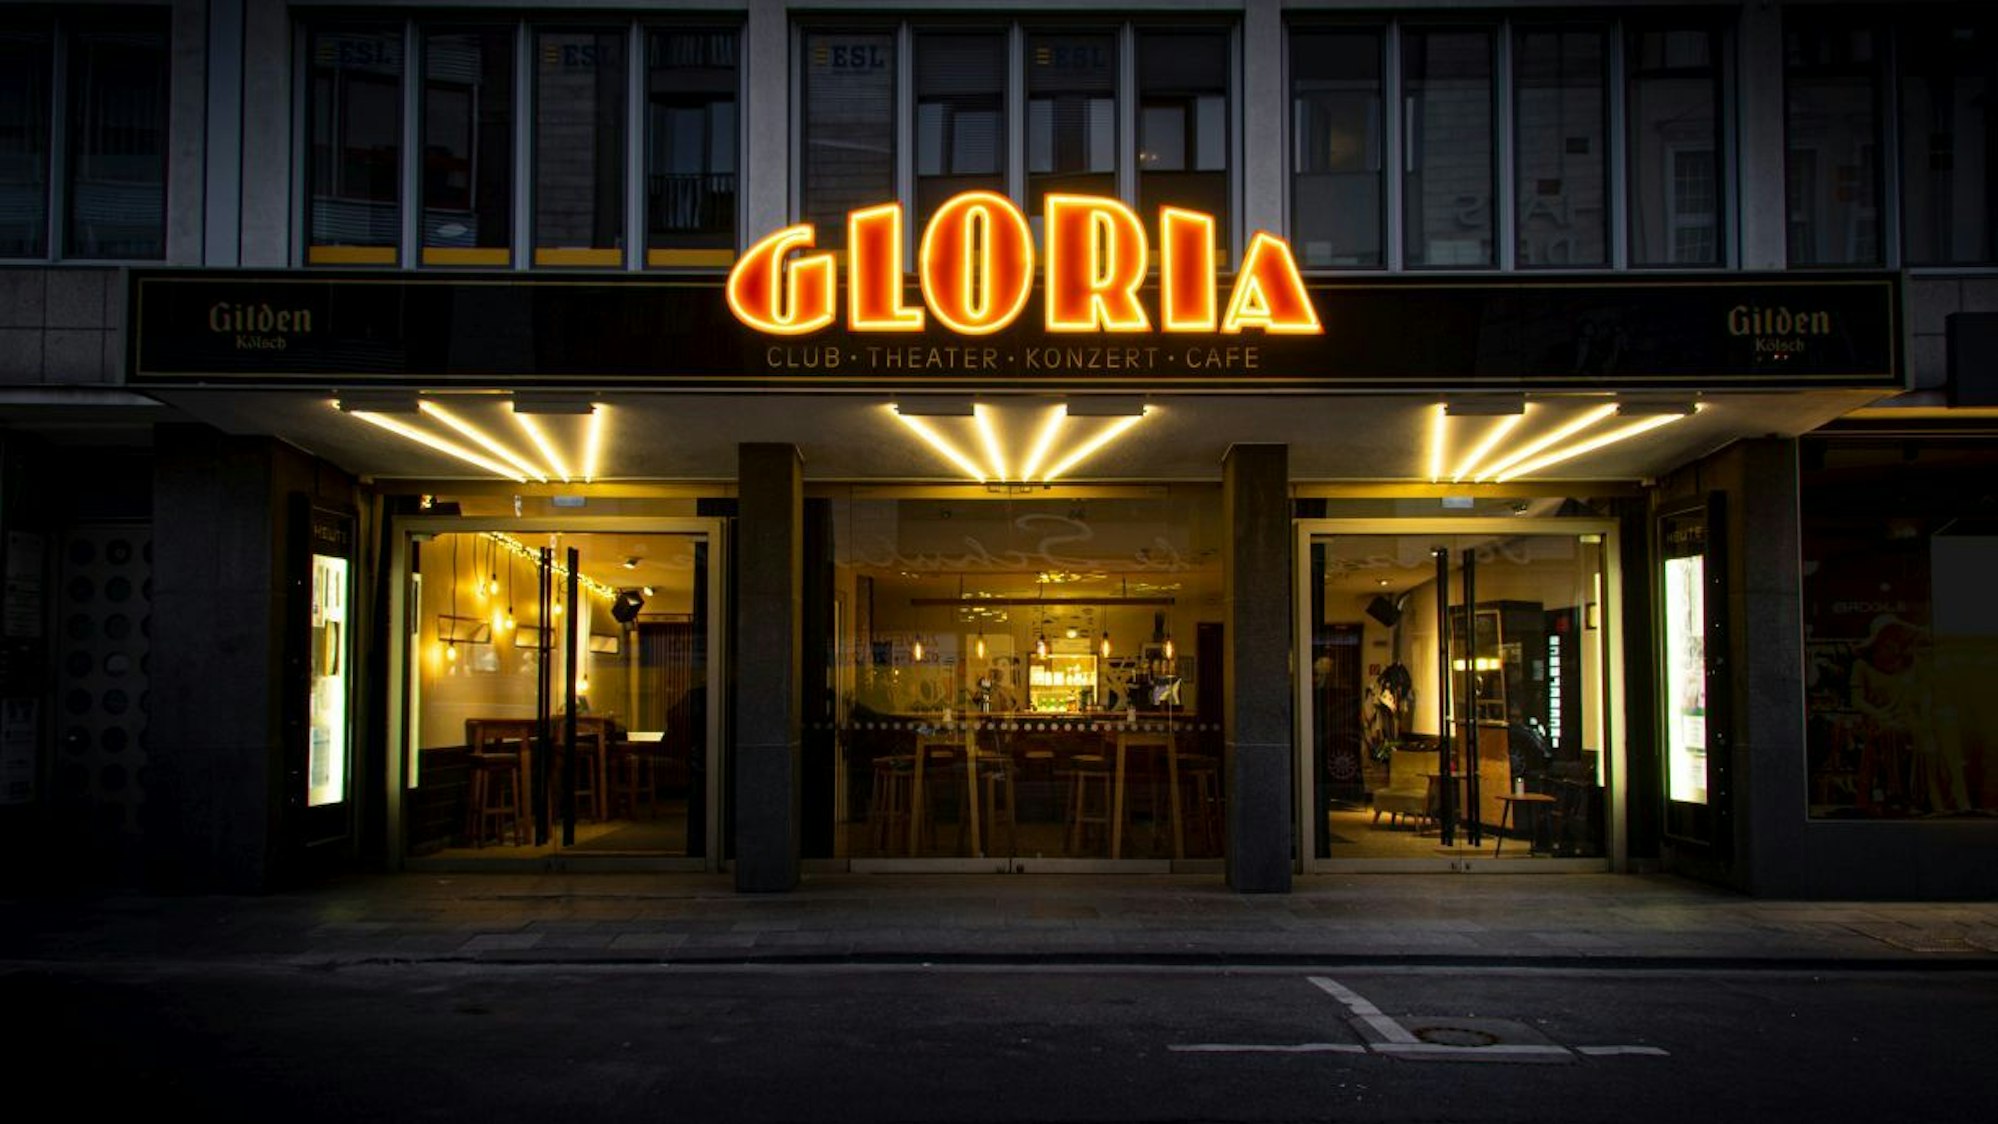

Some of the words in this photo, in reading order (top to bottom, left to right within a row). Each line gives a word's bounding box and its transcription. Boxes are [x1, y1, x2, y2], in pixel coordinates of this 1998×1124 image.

[339, 40, 393, 64] ESL
[831, 45, 885, 68] ESL
[1054, 45, 1107, 68] ESL
[725, 190, 1326, 336] GLORIA
[208, 301, 313, 333] Gilden
[1726, 304, 1831, 336] Gilden
[1755, 337, 1807, 352] Kölsch
[766, 346, 840, 369] CLUB
[866, 347, 999, 369] THEATER
[1025, 347, 1160, 369] KONZERT
[1185, 347, 1260, 369] CAFE
